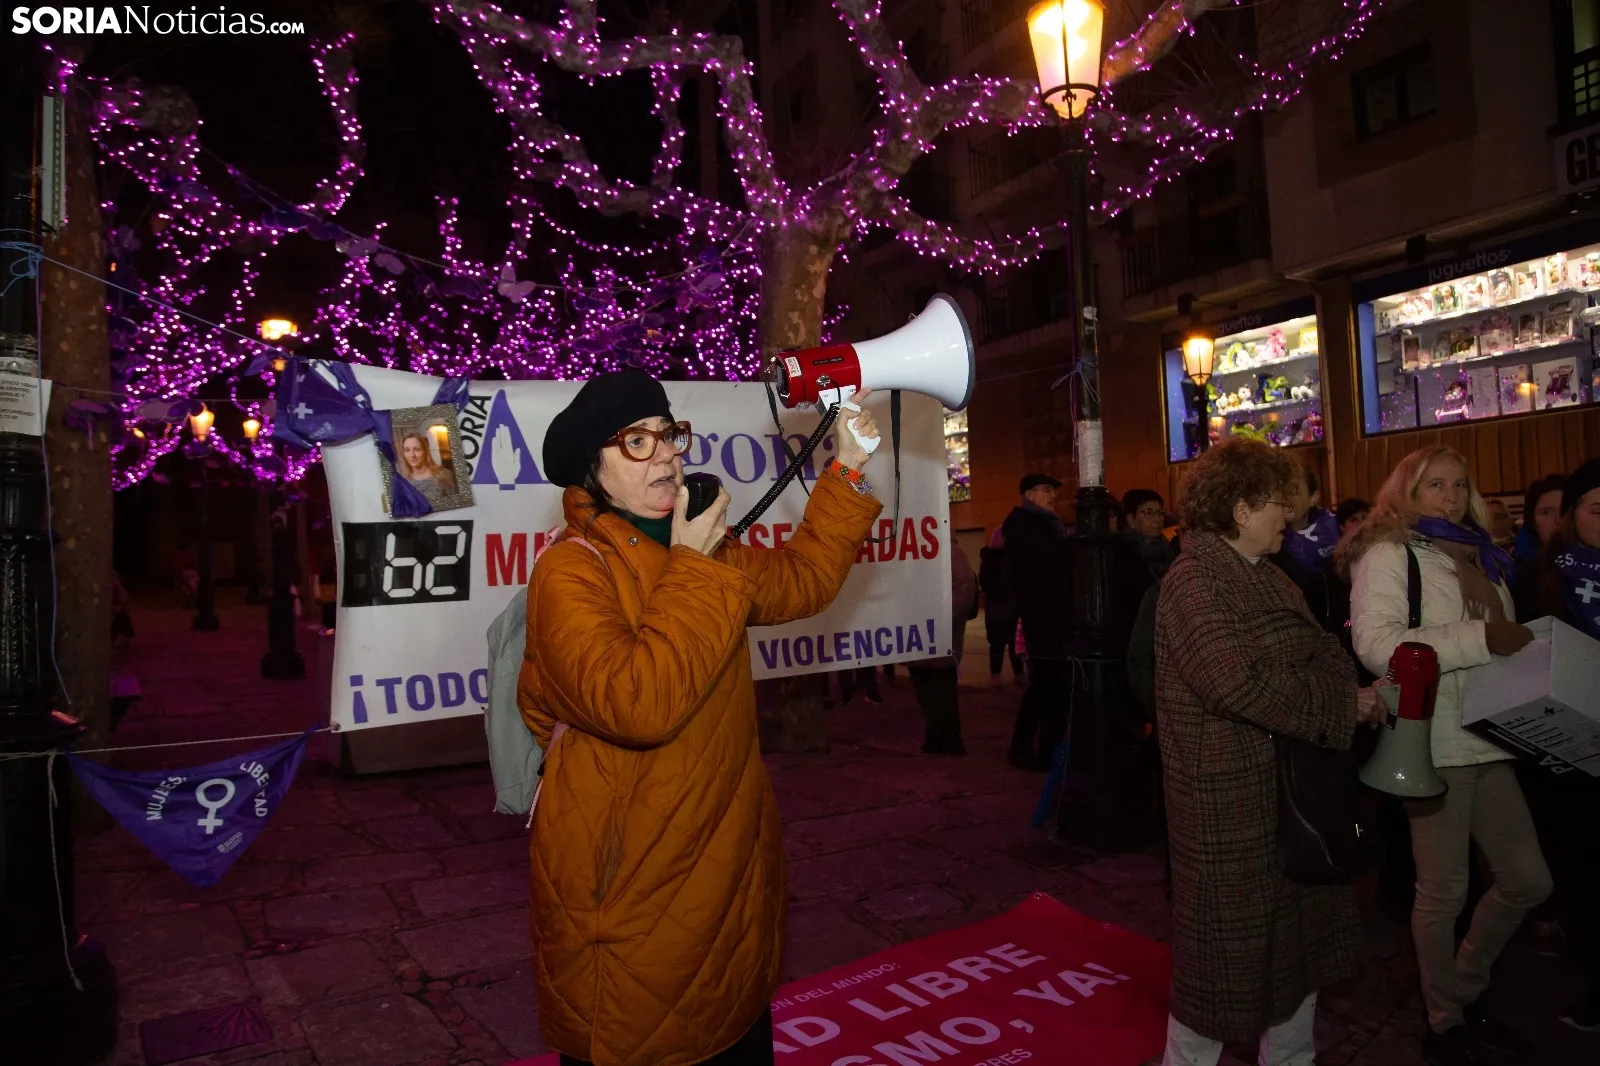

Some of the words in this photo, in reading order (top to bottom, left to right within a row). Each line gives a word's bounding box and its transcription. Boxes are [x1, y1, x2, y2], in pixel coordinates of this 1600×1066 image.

[1217, 313, 1262, 335] guettos
[757, 618, 937, 670] VIOLENCIA!
[349, 668, 489, 725] ¡TODO
[793, 988, 834, 1003] DEL
[832, 962, 902, 990] MUNDO:
[846, 941, 1048, 1021] LIBRE
[1012, 961, 1133, 1007] YA!
